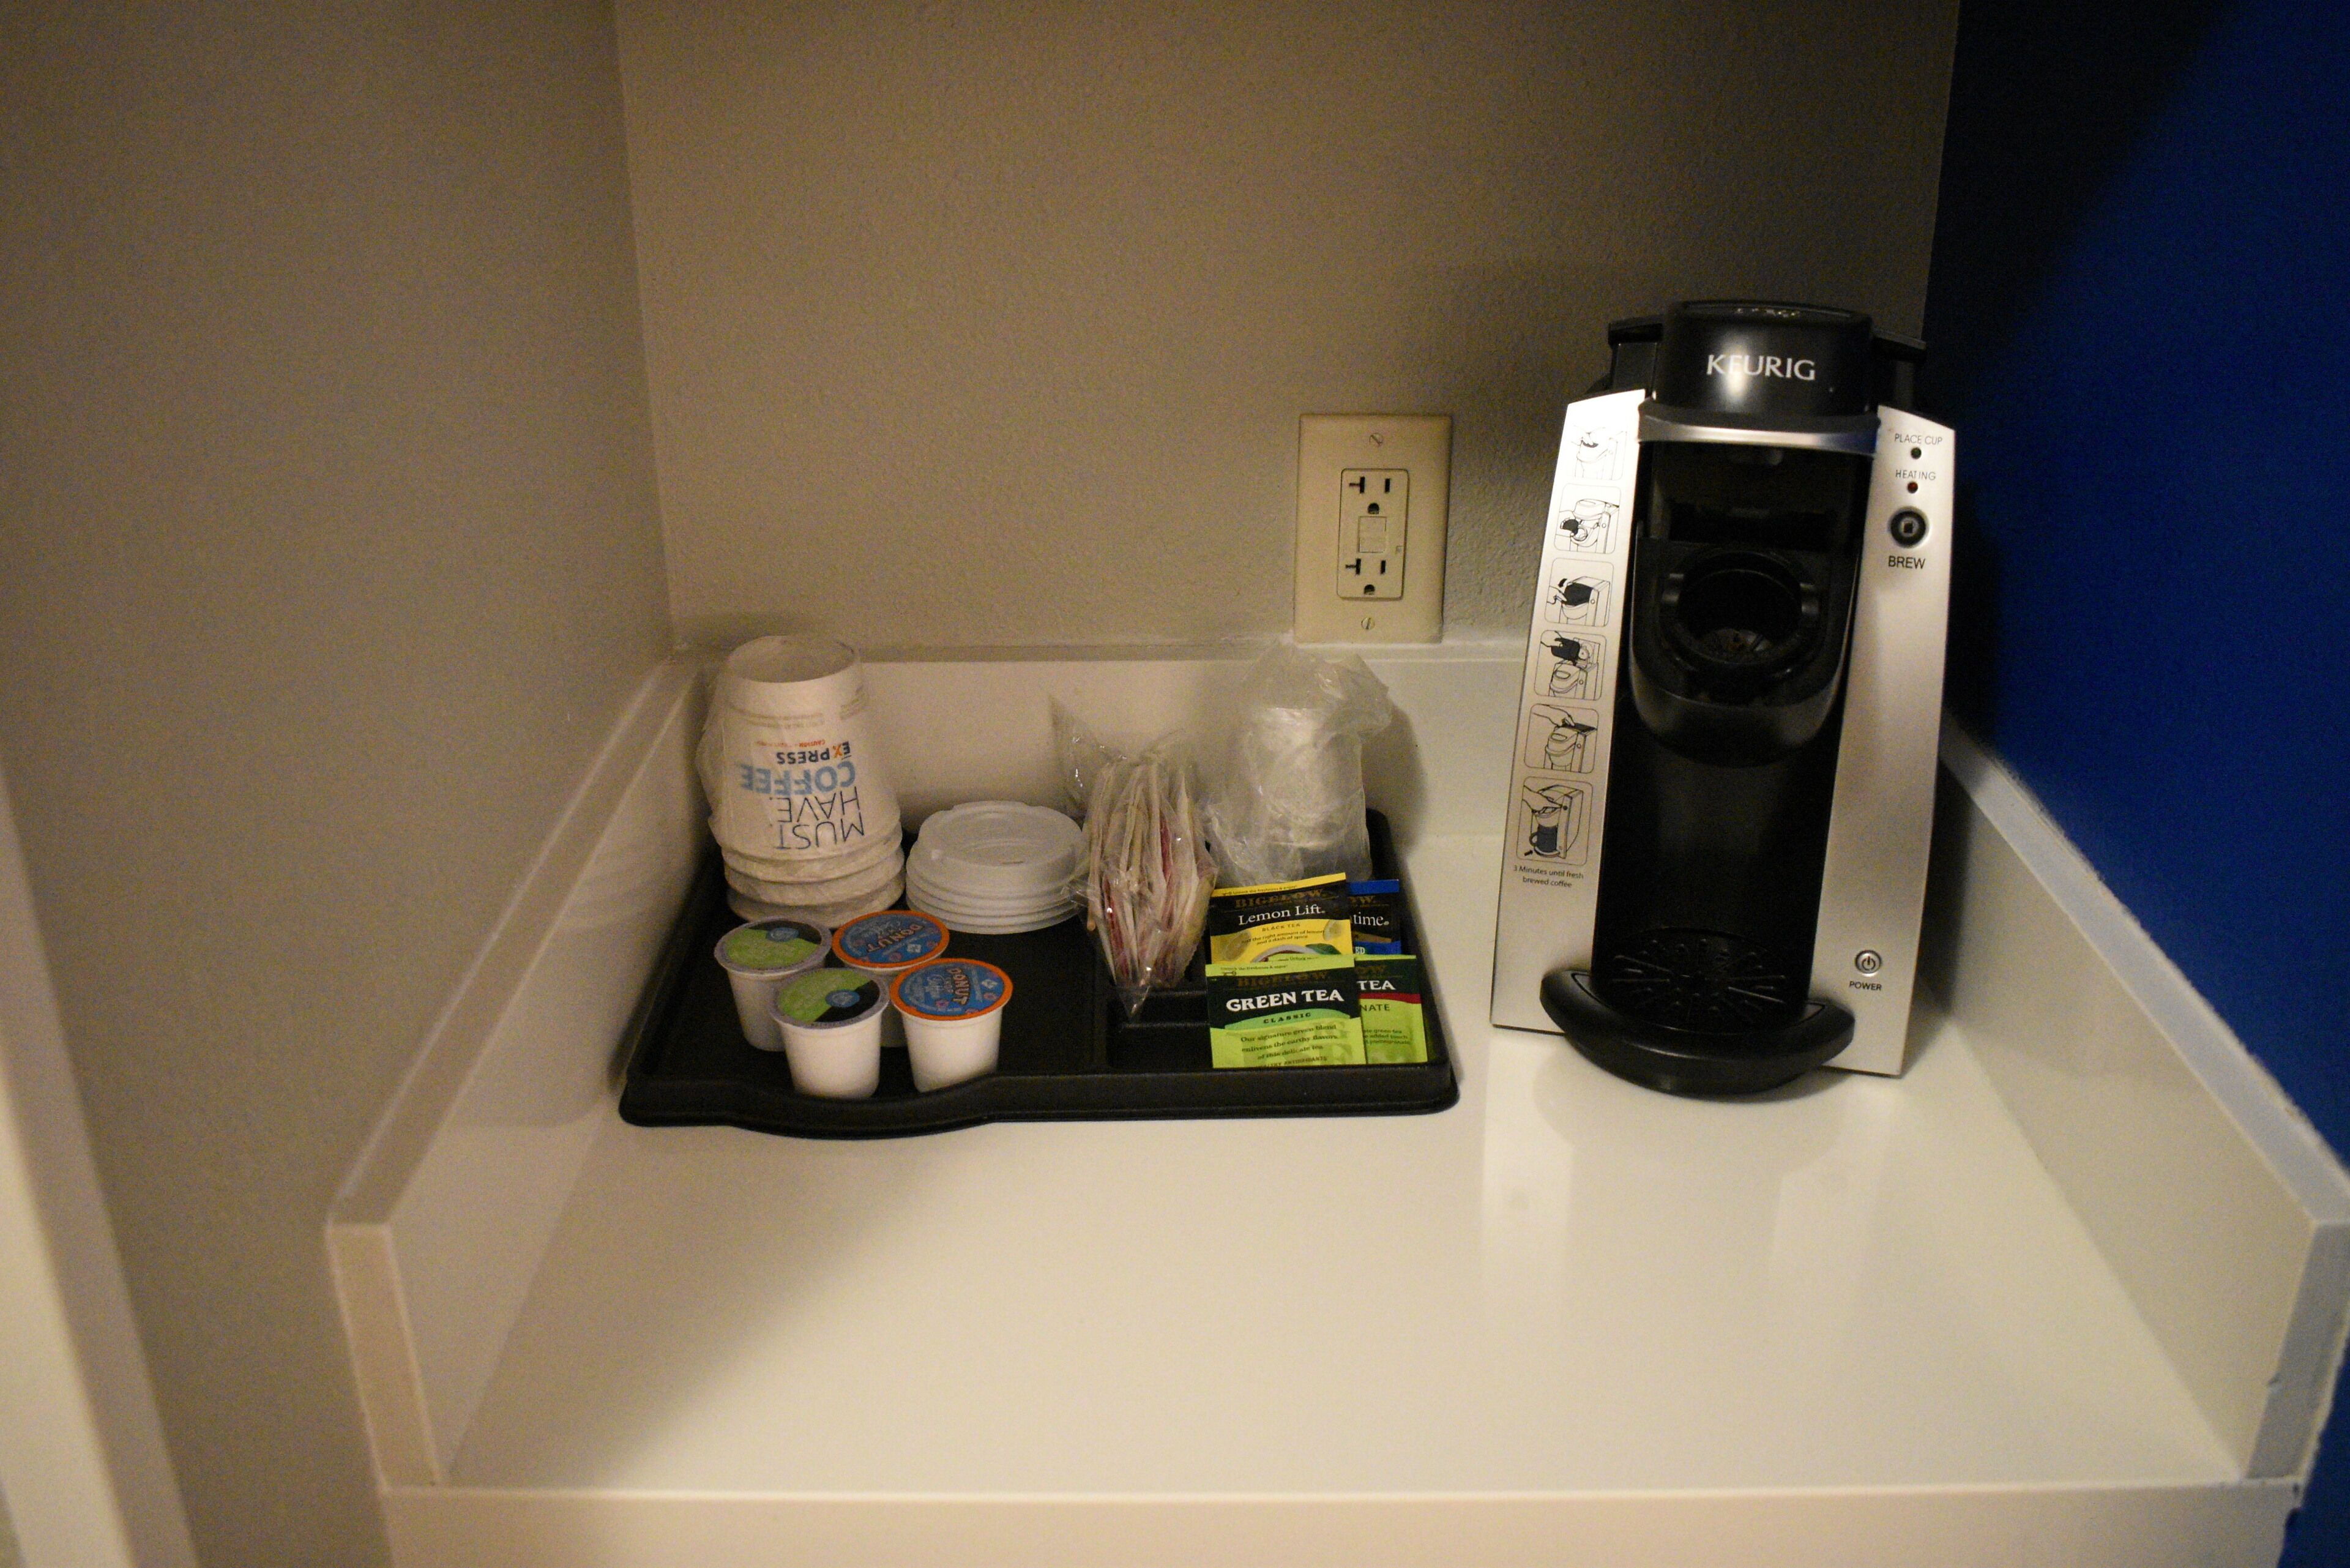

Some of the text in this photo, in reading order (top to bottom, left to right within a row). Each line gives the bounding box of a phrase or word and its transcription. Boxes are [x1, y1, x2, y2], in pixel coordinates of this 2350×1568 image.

[1706, 354, 1816, 381] KEURIG
[1894, 433, 1943, 446] PLACE CUP
[1895, 469, 1936, 480] HEATING
[1888, 554, 1926, 569] BREW
[740, 761, 856, 796] COFFEE
[1519, 866, 1547, 875] Minutes
[1523, 876, 1549, 886] brewed
[1238, 909, 1291, 925] Lemon
[1351, 911, 1384, 926] time
[867, 923, 924, 954] DONUT
[949, 967, 971, 1006] DONUT
[1356, 980, 1396, 990] TEA
[1849, 980, 1882, 991] POWER
[1226, 989, 1345, 1012] GREEN TEA
[1360, 1003, 1391, 1012] NATE
[1263, 1012, 1311, 1024] CLASSIC
